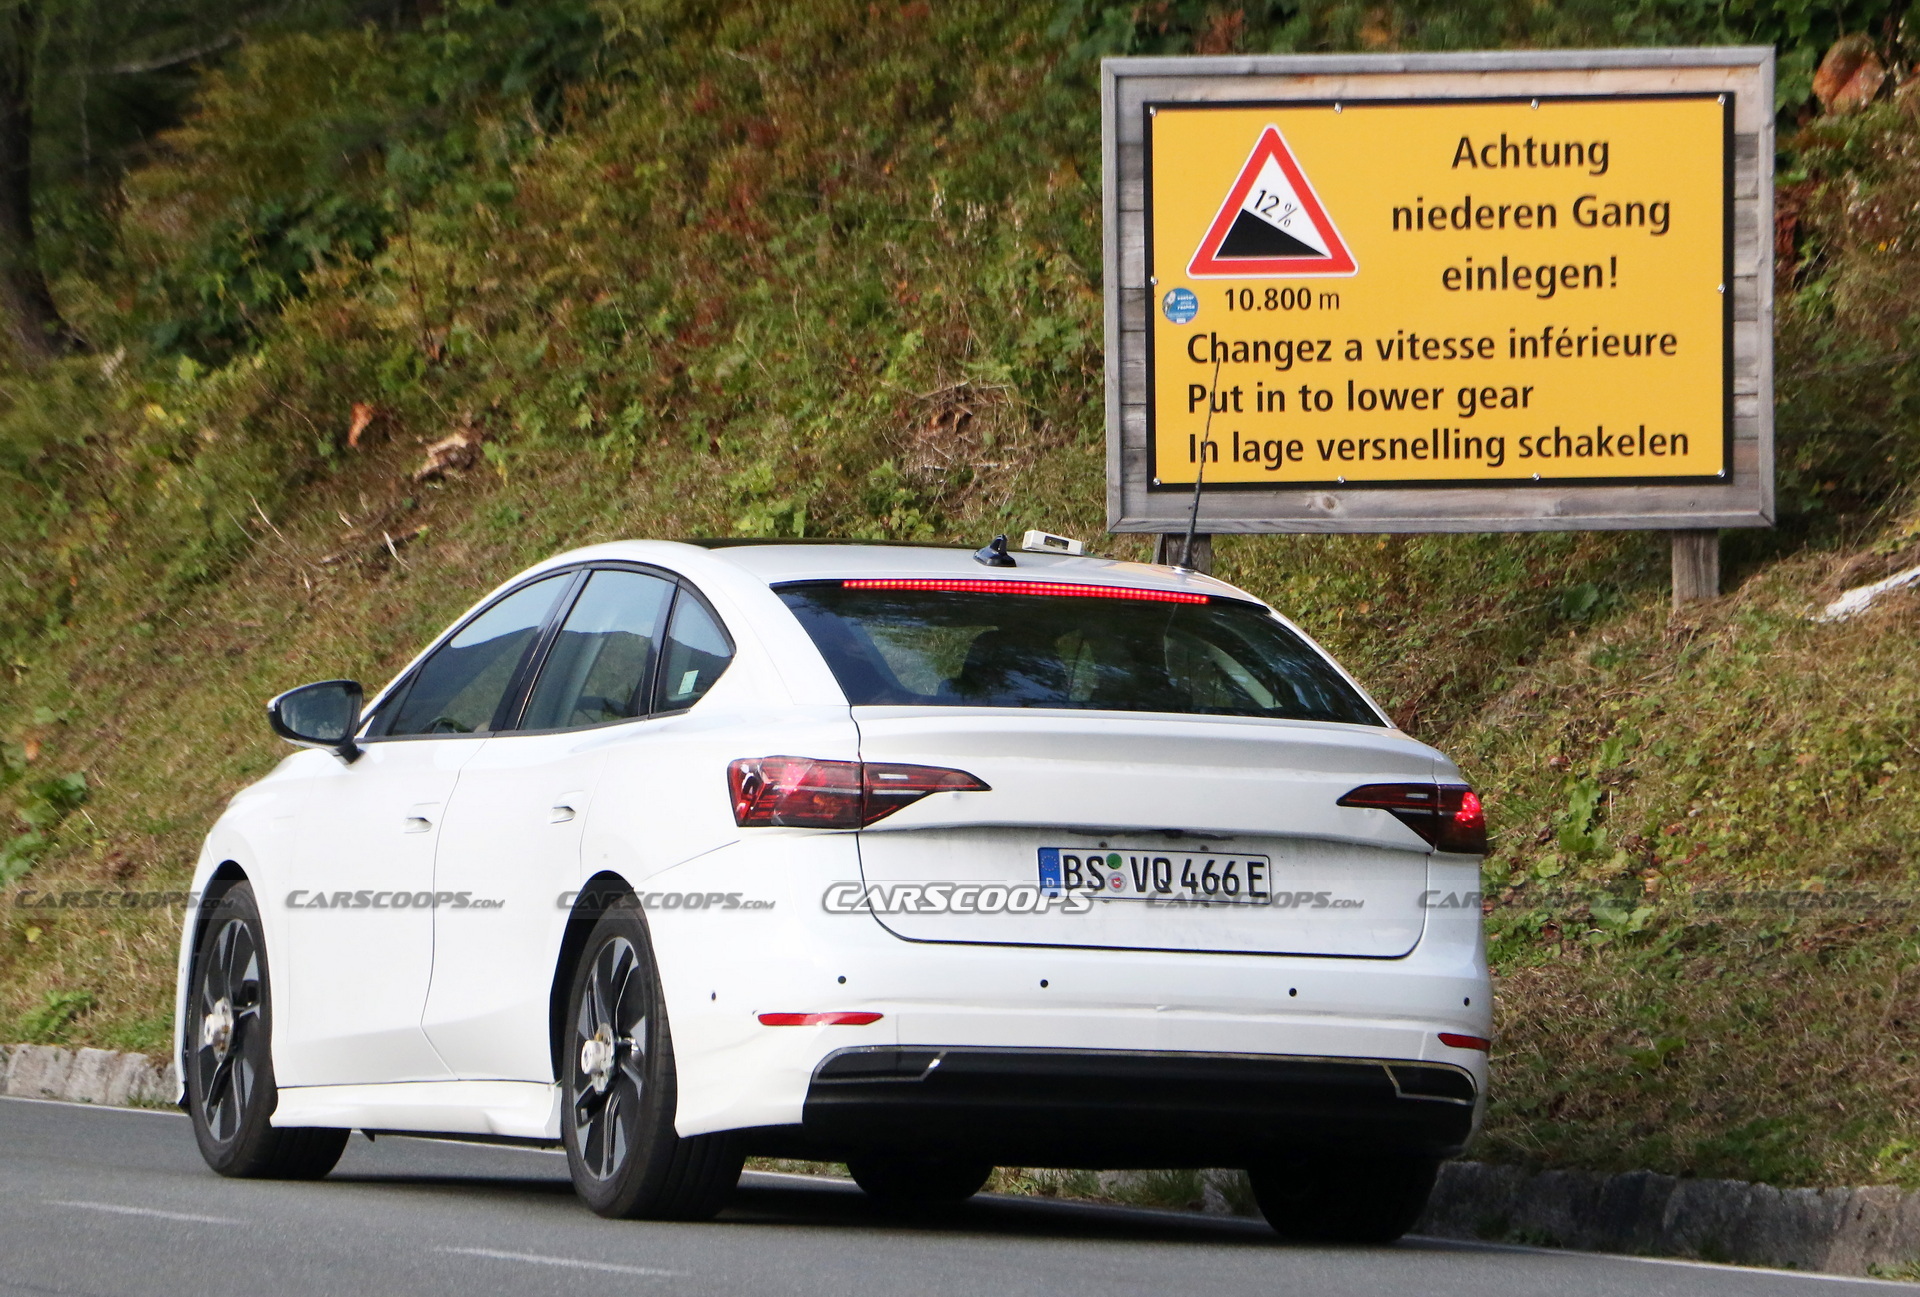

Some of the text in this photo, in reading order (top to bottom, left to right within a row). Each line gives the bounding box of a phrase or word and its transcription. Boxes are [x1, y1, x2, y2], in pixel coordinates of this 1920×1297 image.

[1451, 133, 1610, 175] Achtung
[1391, 195, 1671, 235] niederen Gang
[1441, 256, 1618, 299] einlegen!
[1224, 287, 1340, 311] 10.800 m
[1186, 325, 1678, 373] Changez a vitesse inférieure
[1187, 380, 1535, 418] Put in to lower gear
[1188, 425, 1689, 471] In lage versnelling schakelen
